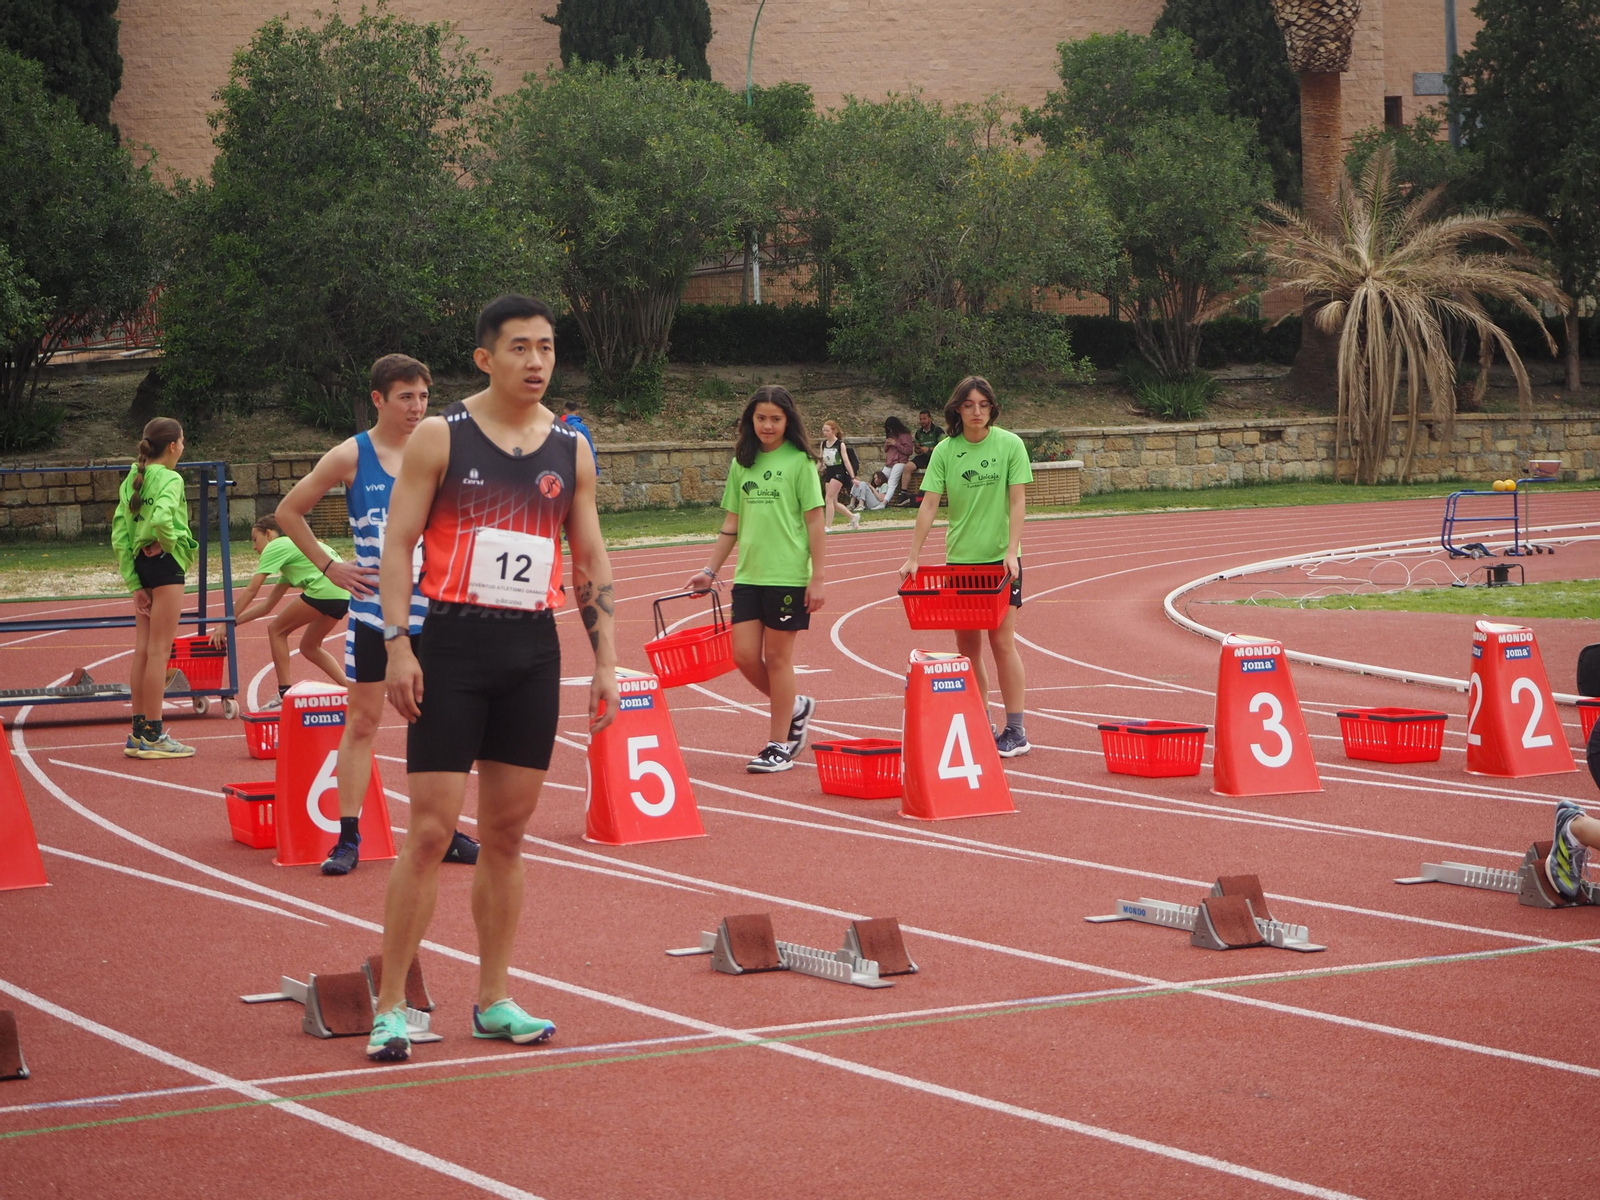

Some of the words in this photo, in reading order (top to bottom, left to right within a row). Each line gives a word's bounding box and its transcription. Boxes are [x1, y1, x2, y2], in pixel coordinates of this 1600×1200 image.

[978, 473, 999, 481] Unicaja
[365, 483, 386, 493] vive
[757, 489, 780, 498] Unicaja
[496, 551, 532, 583] 12
[468, 581, 496, 590] JUVENTUD
[497, 585, 525, 593] ATLETISMO
[1498, 632, 1534, 643] MONDO
[1234, 645, 1281, 657] MONDO
[923, 661, 969, 675] MONDO
[1510, 676, 1553, 749] 2
[1249, 691, 1293, 768] 3
[937, 713, 983, 789] 4
[627, 734, 676, 817] 5
[306, 750, 363, 834] 6
[1122, 905, 1146, 917] MONDO
